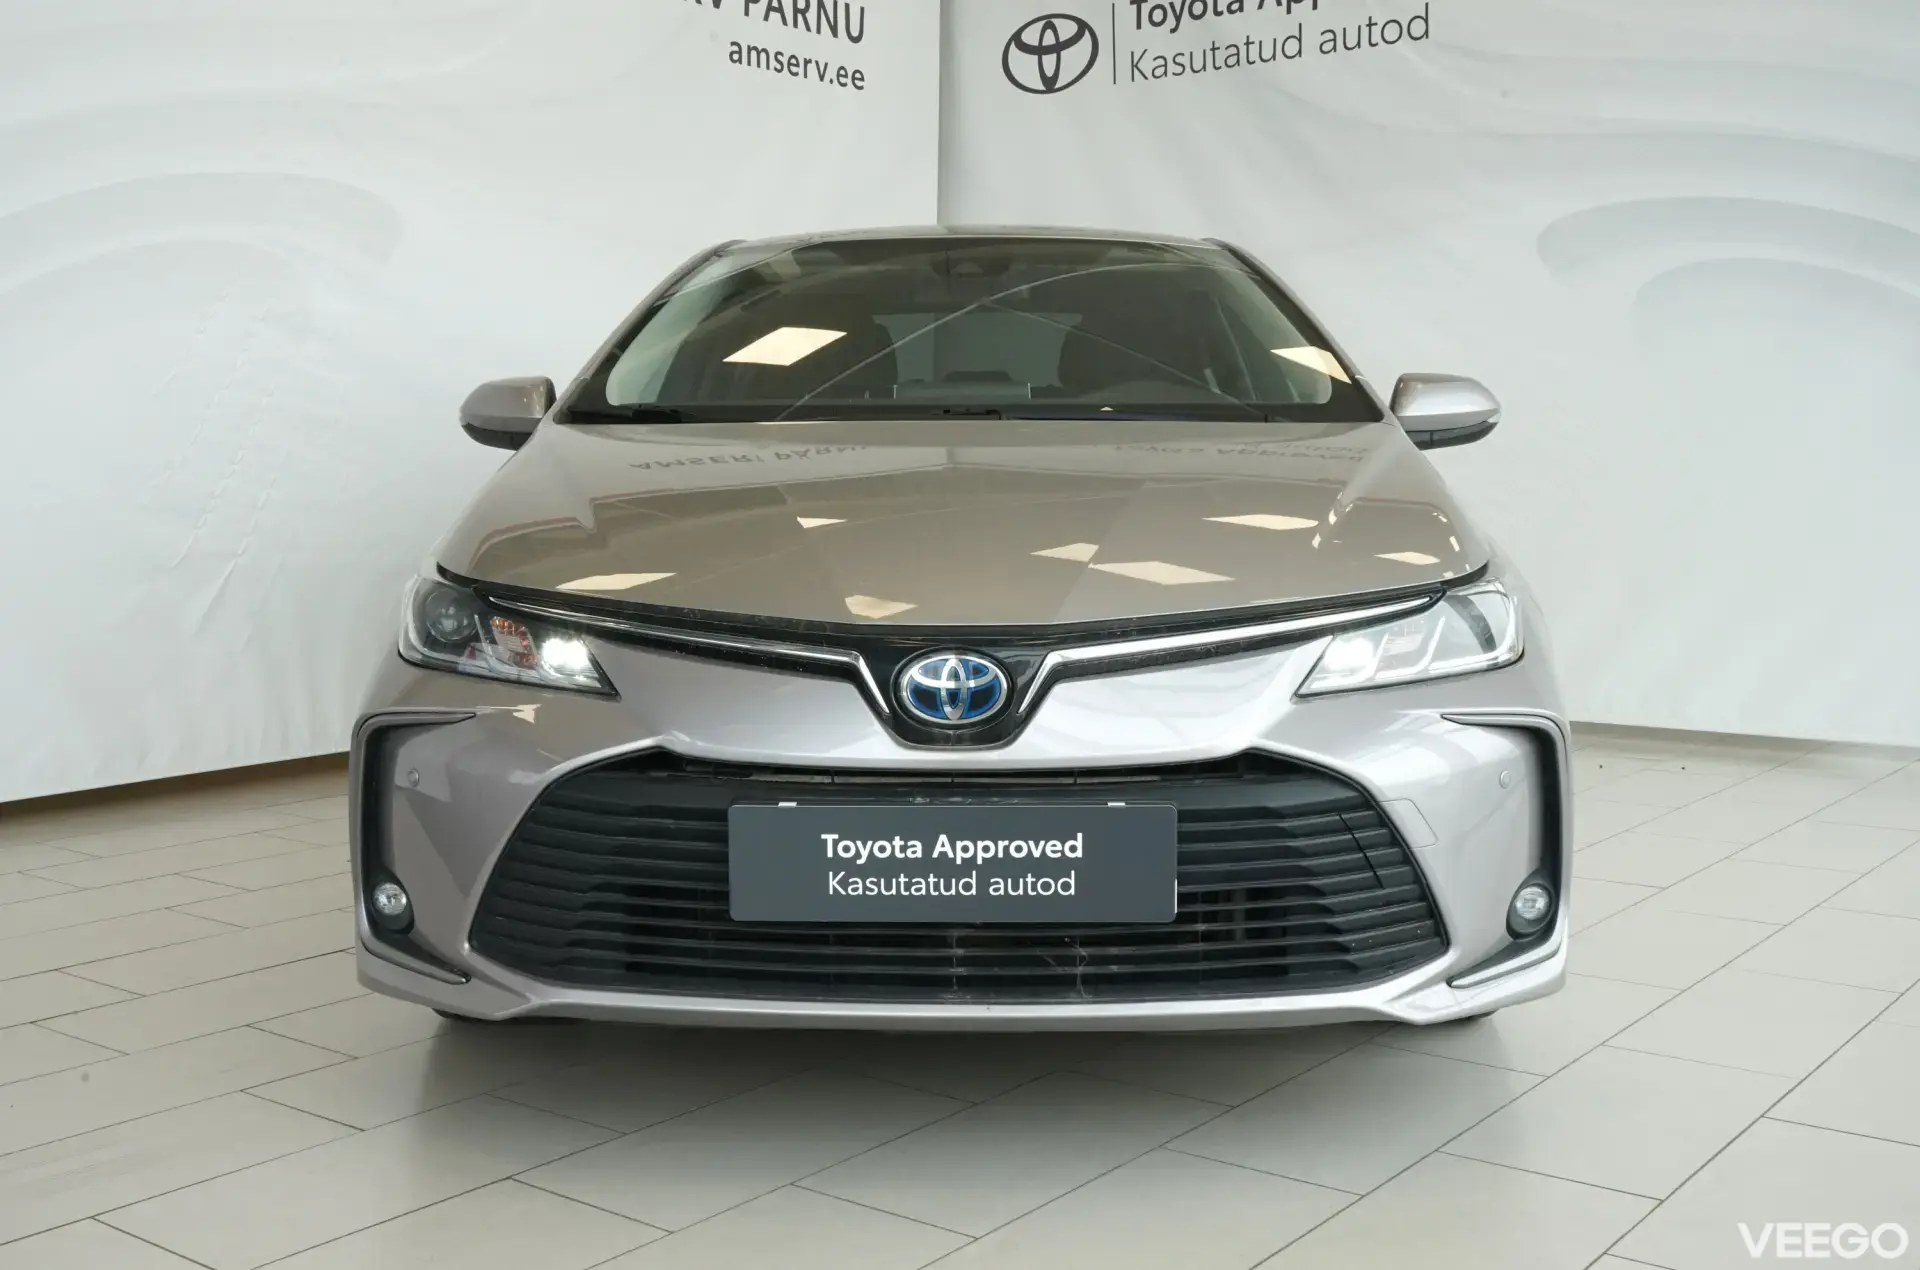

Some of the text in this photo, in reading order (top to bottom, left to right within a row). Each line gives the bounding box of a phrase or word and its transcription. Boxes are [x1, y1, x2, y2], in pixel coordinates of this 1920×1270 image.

[1130, 2, 1430, 82] Kasutatud autod
[728, 41, 865, 91] amserv.ee
[821, 833, 1083, 864] Toyota Approved
[828, 870, 1076, 896] Kasutatud autod
